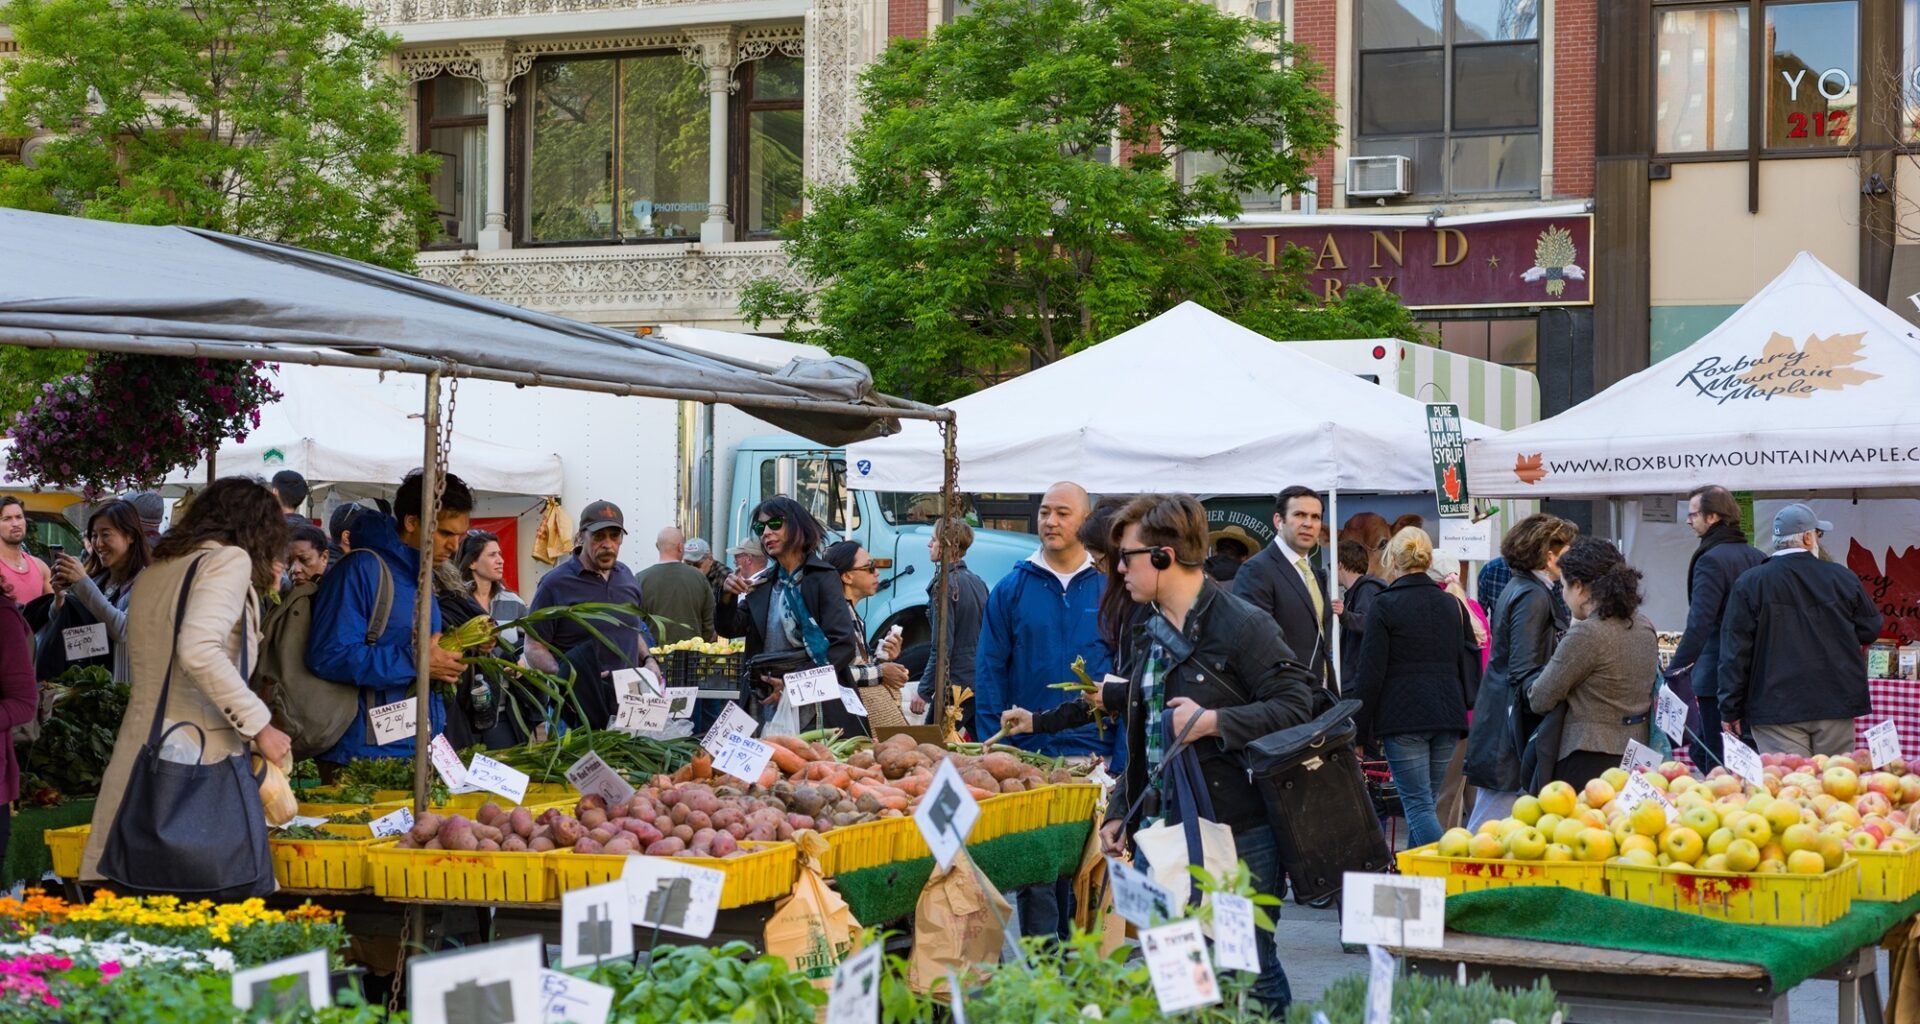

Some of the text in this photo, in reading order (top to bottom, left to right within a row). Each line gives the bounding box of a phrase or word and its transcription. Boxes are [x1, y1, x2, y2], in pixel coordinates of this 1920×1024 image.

[654, 203, 709, 212] PHOTOSHELTE
[1676, 351, 1809, 399] Roxbury
[1697, 365, 1832, 397] Mountain
[1717, 379, 1818, 405] Maple
[1433, 406, 1452, 417] PURE
[1430, 417, 1460, 432] NEW YORK
[1432, 433, 1462, 448] MAPLE
[1434, 448, 1463, 464] SYRUP
[1441, 503, 1469, 513] FOR SALE HERE
[1228, 511, 1275, 541] HUBBERT
[370, 702, 407, 716] CILANTRO
[729, 734, 764, 753] RED BEETS
